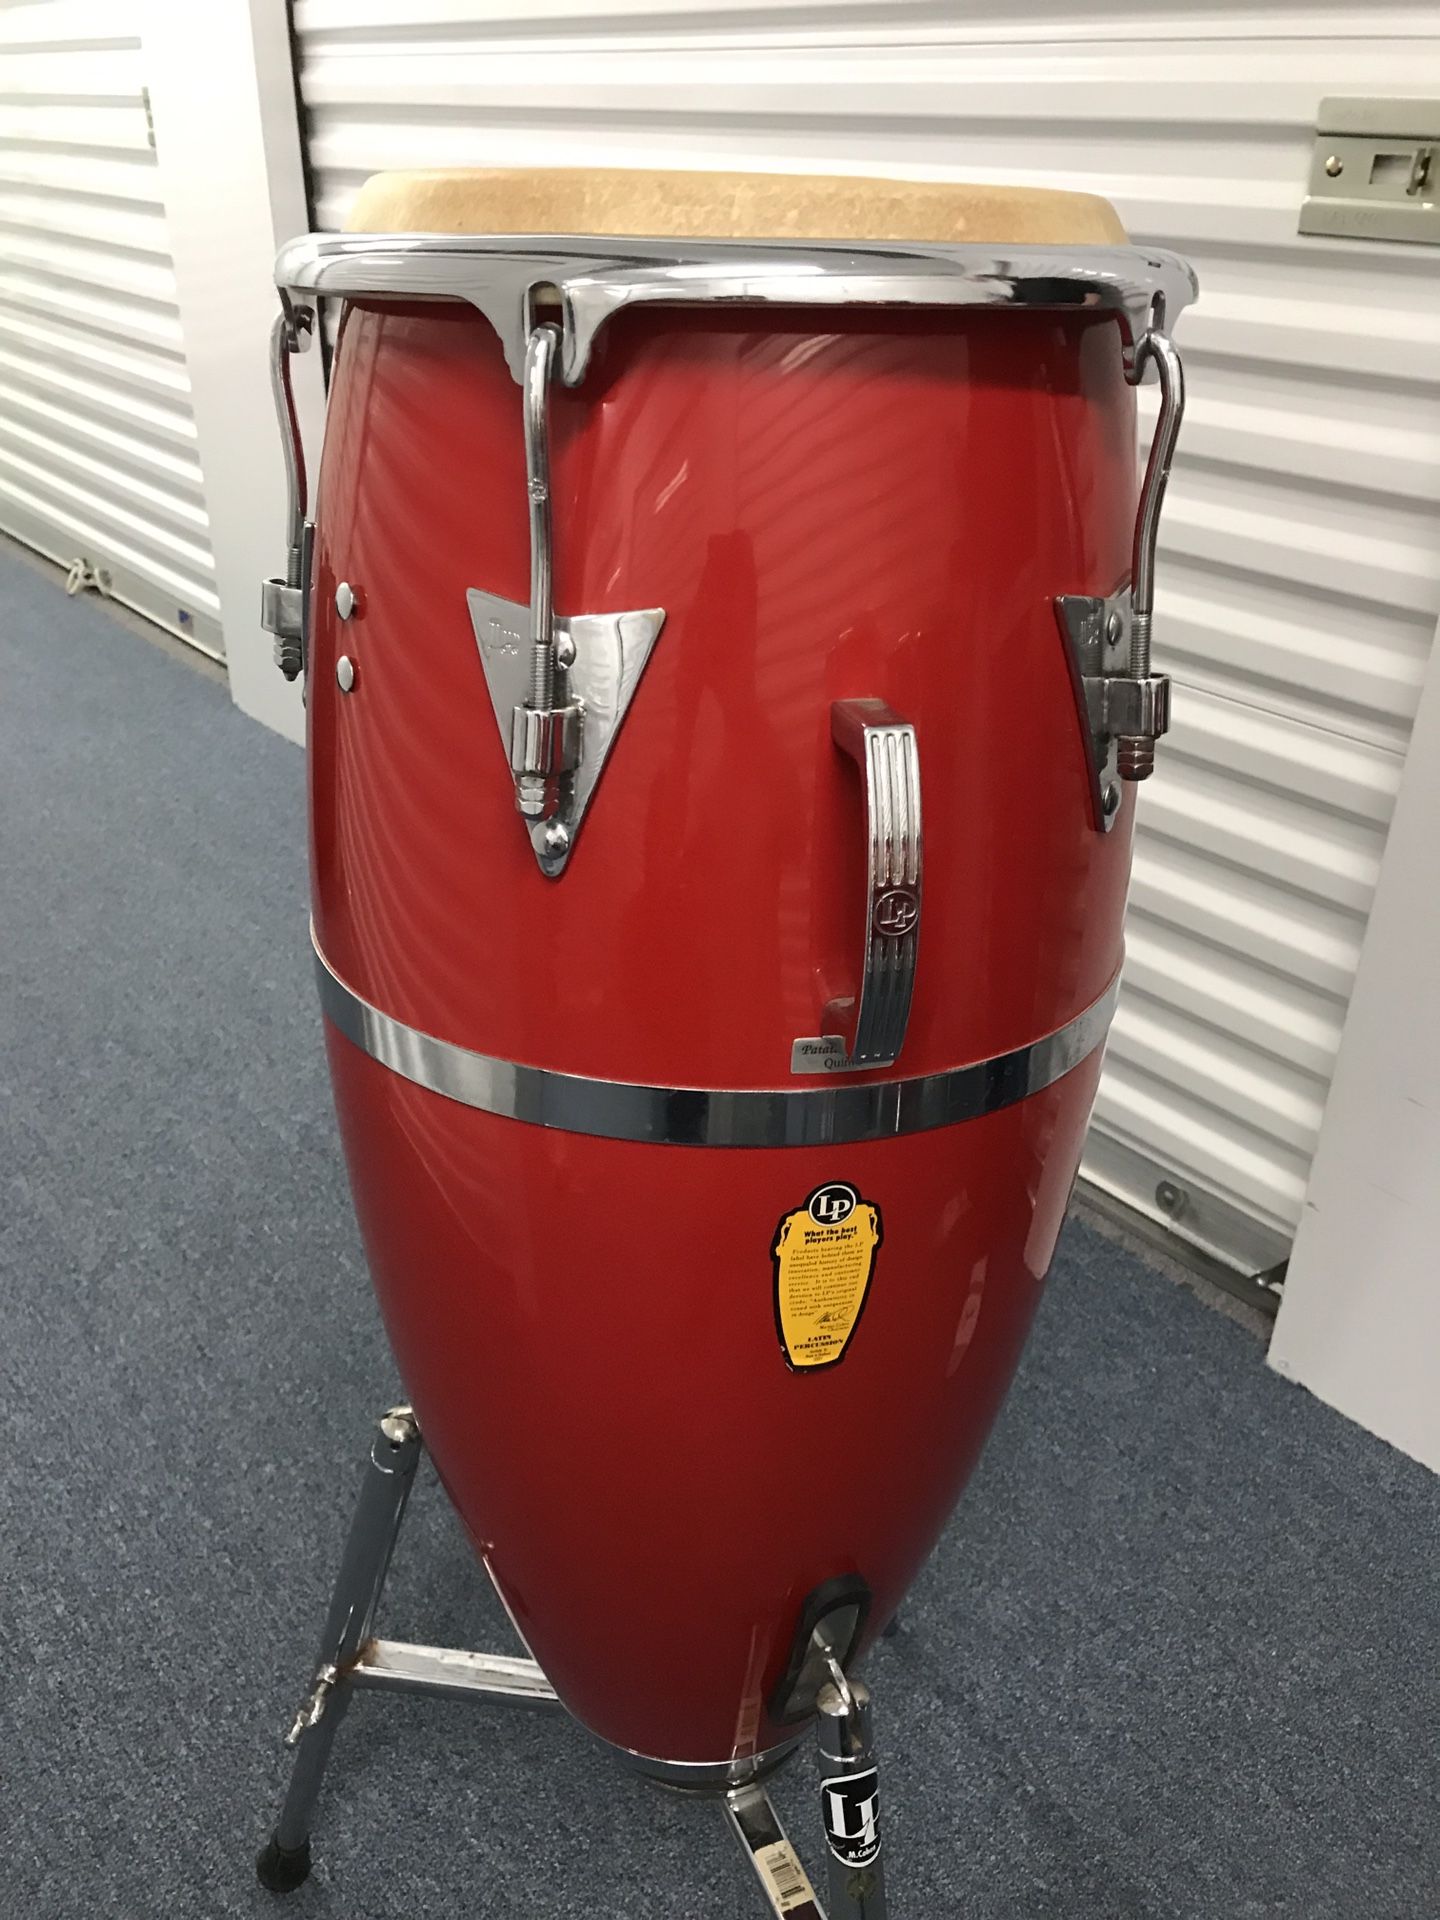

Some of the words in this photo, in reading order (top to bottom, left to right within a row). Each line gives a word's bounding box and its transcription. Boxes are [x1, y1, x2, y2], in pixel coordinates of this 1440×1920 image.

[817, 1194, 851, 1221] LP
[804, 1230, 824, 1238] What
[826, 1228, 839, 1236] the
[842, 1226, 858, 1234] best
[804, 1234, 834, 1245] players
[794, 1338, 844, 1350] PERCUSSION
[808, 1334, 832, 1342] LATIN
